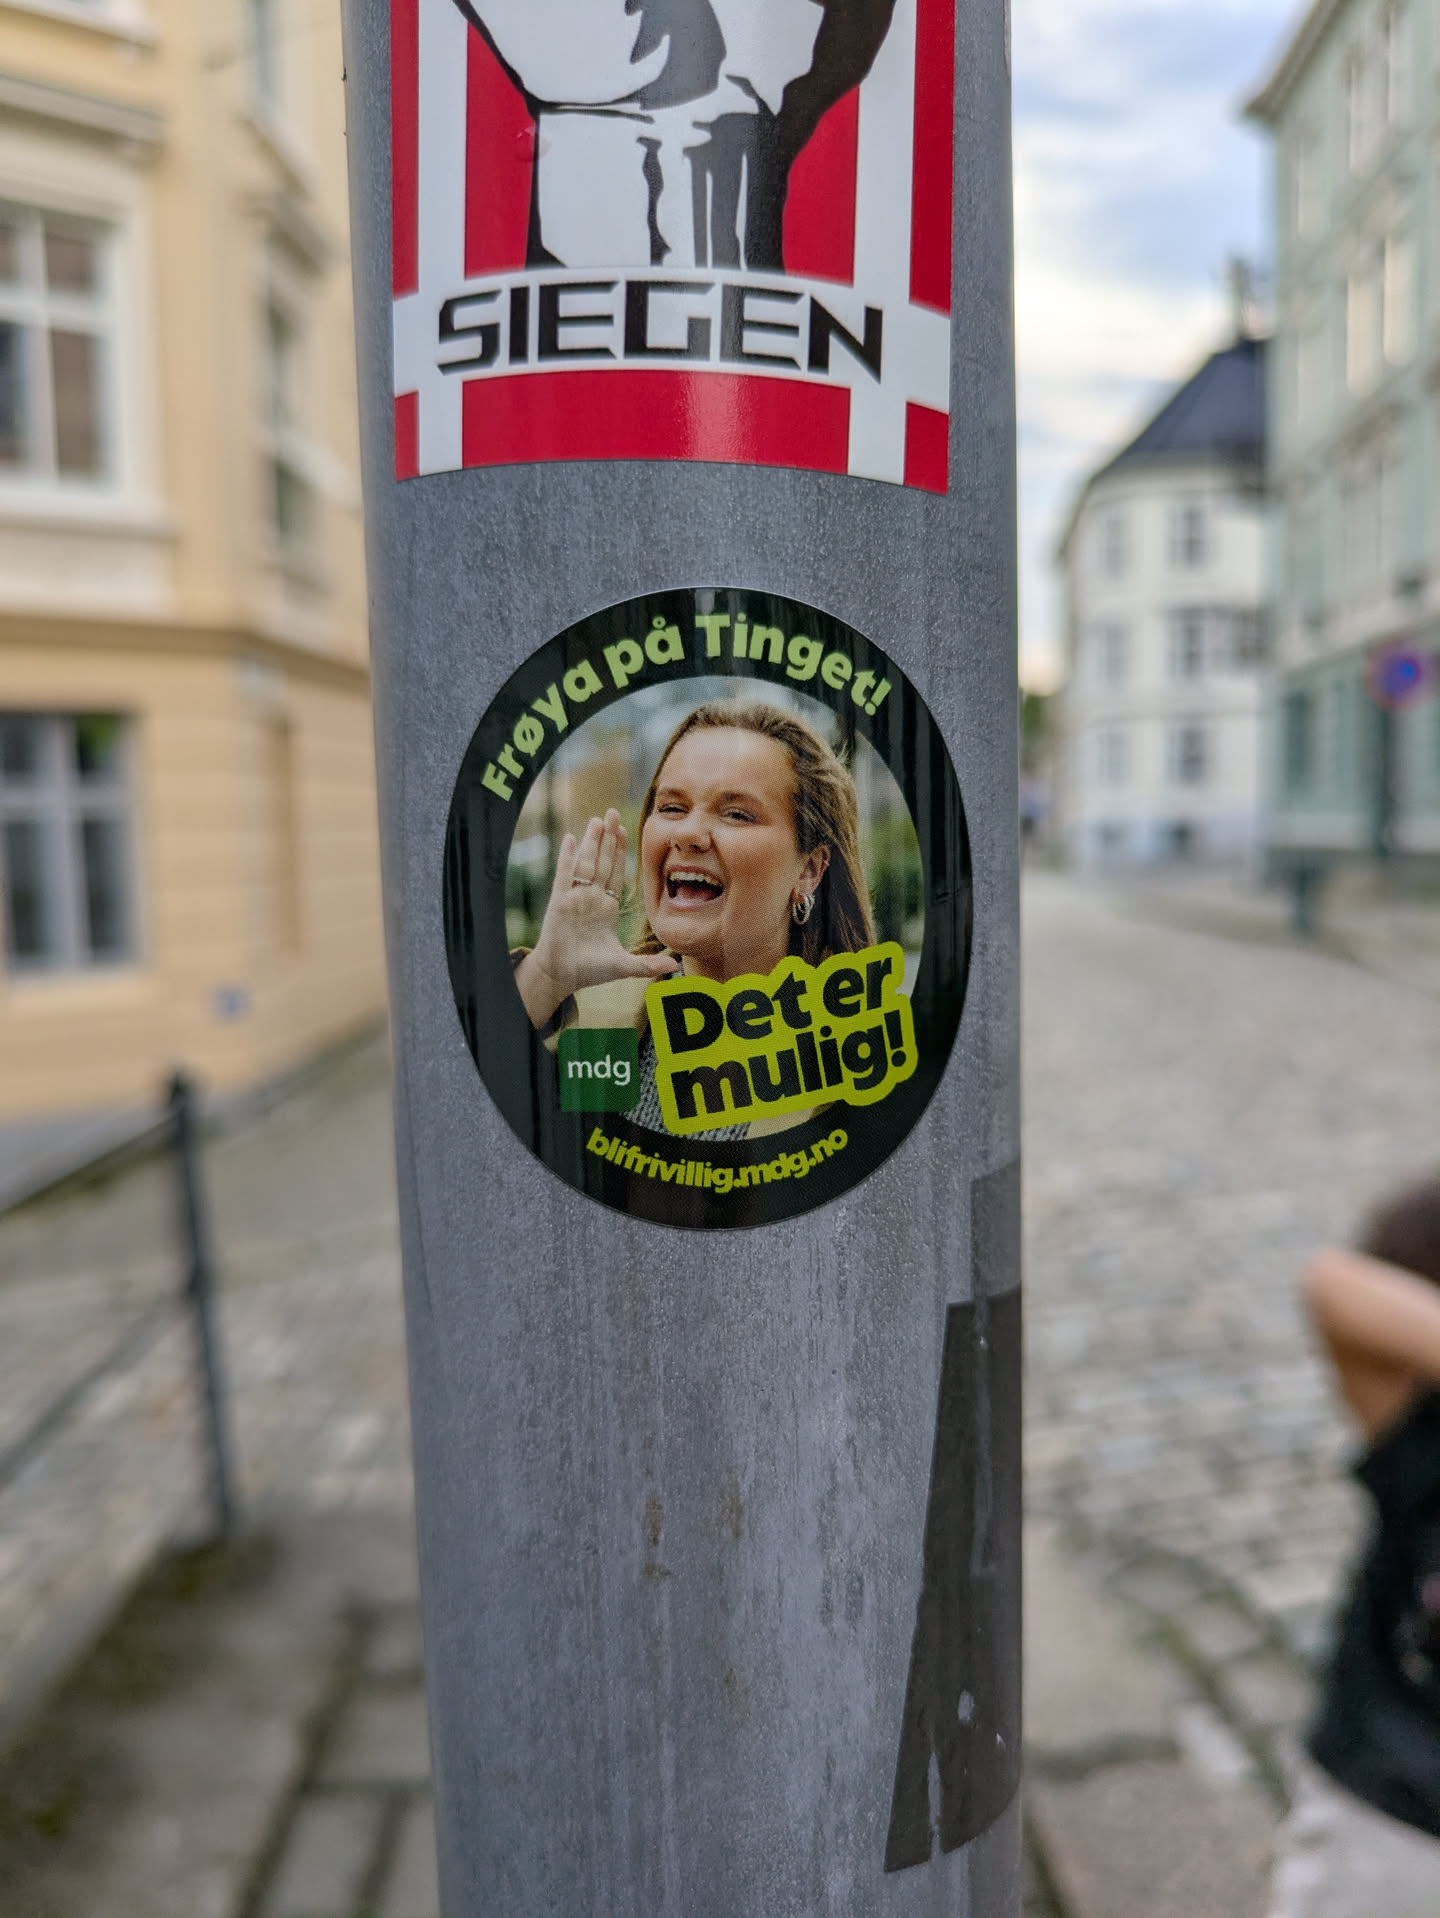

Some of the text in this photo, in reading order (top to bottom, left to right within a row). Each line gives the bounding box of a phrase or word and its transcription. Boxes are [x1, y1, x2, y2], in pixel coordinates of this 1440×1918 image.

[437, 280, 884, 385] SIEGEN
[482, 613, 893, 802] Frøya på Tinget!
[661, 956, 894, 1055] Det er
[566, 1054, 632, 1086] mdg
[669, 1010, 907, 1120] mulig!
[586, 1127, 849, 1194] blifrivillig.mdg.no
